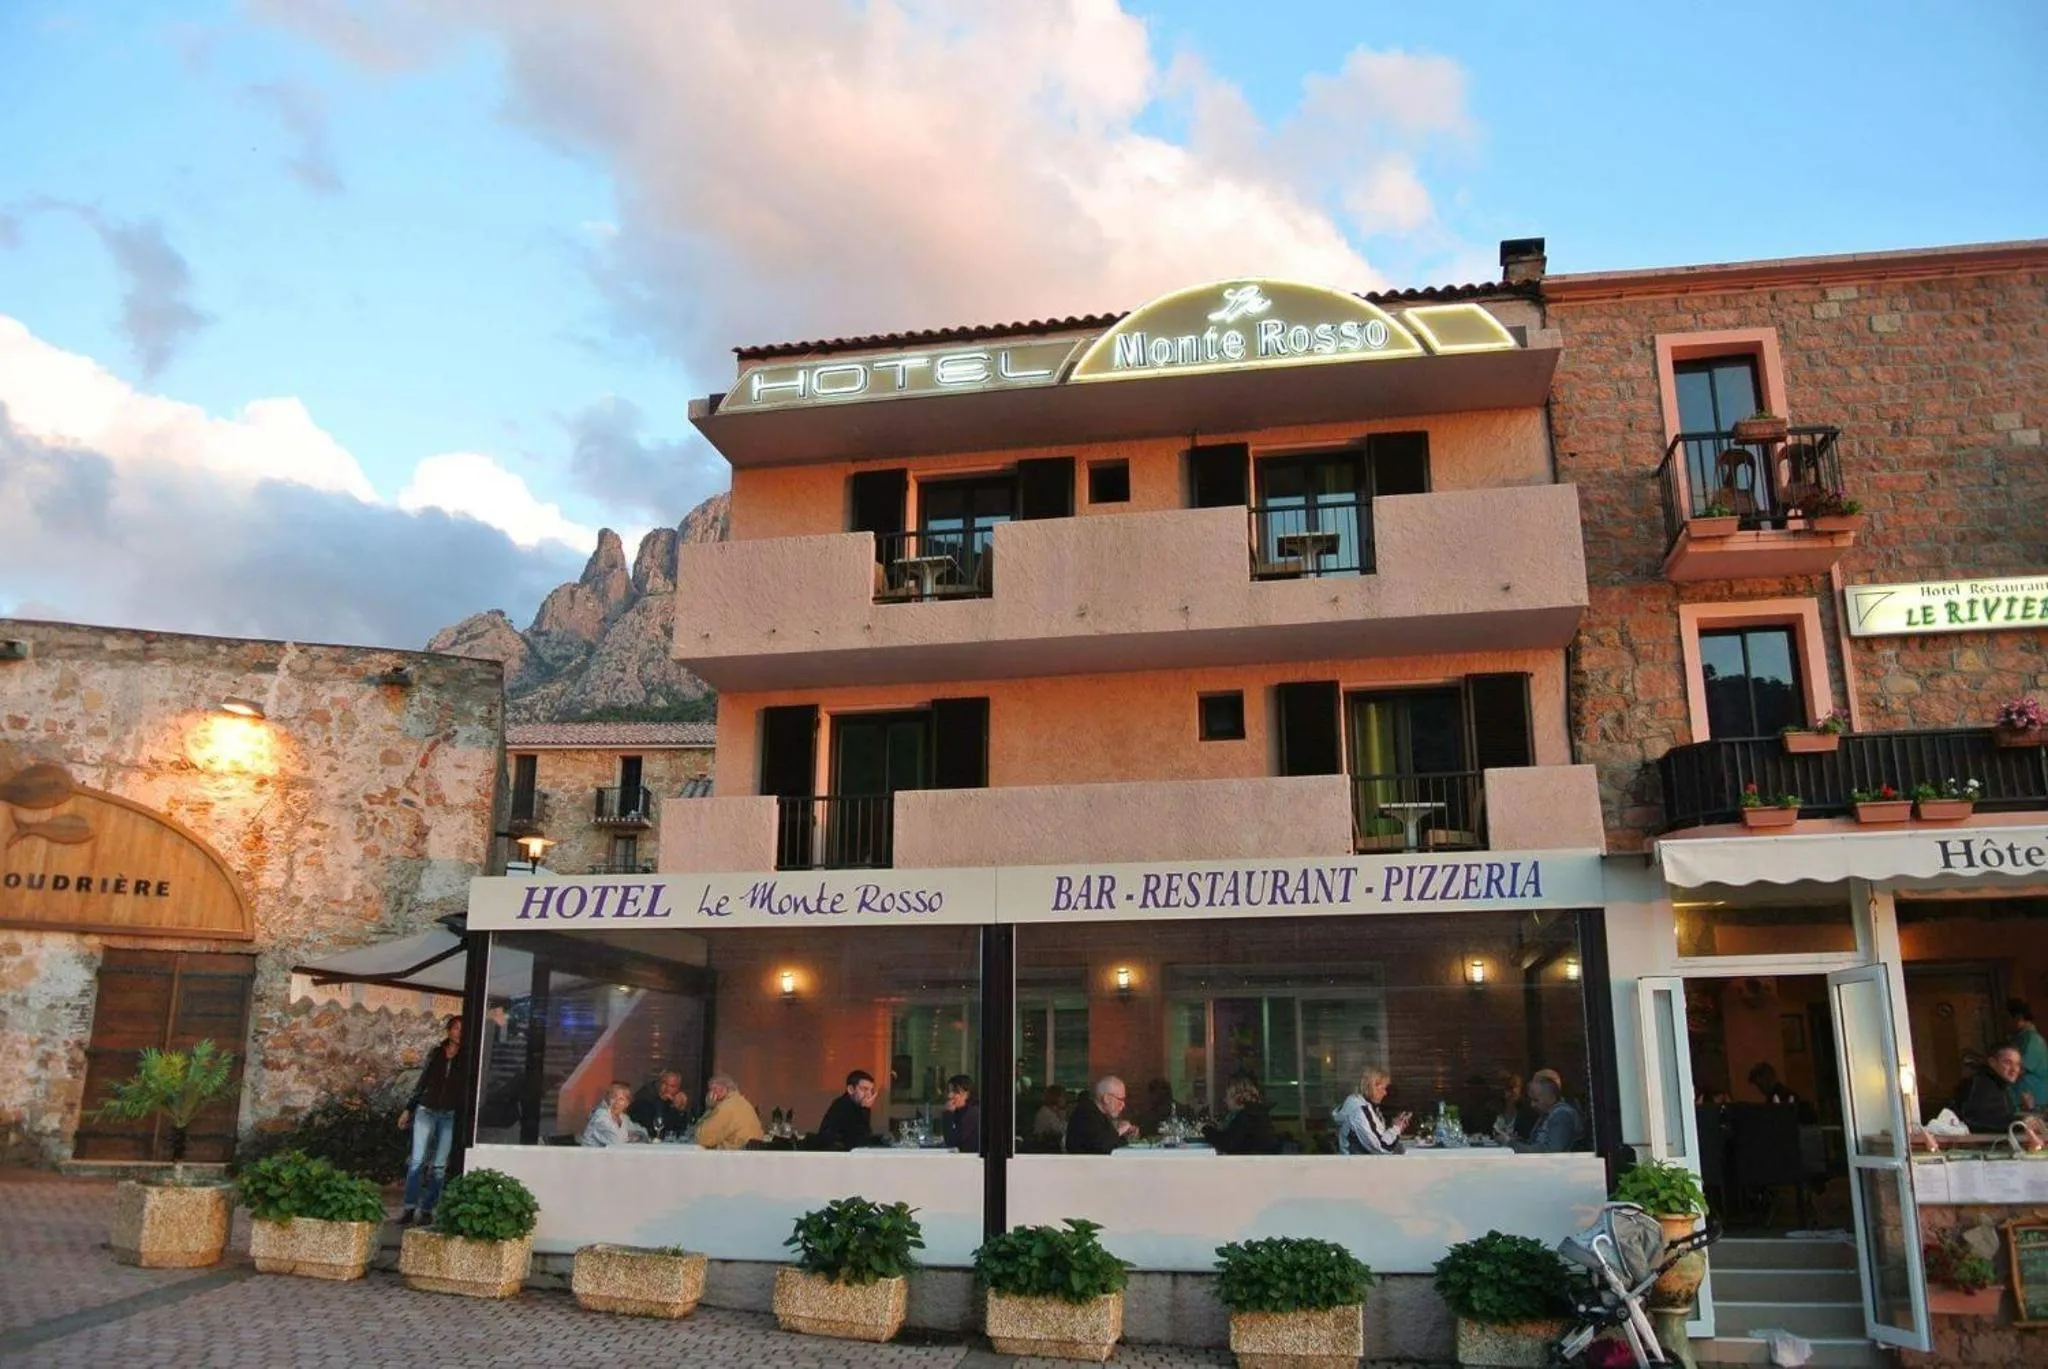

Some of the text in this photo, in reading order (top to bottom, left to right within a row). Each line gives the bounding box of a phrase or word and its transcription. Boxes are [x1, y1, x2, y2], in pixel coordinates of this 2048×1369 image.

[1113, 318, 1390, 370] Monte Rosso
[752, 350, 1053, 403] HOTEL
[1920, 583, 1961, 597] Hotel
[1905, 604, 1937, 627] LE
[1935, 836, 2048, 869] Hôte
[516, 881, 944, 920] HOTEL Le Monte Rosso
[1051, 875, 1117, 912] BAR
[1139, 867, 1358, 909] RESTAURANT
[1381, 860, 1544, 903] PIZZERIA
